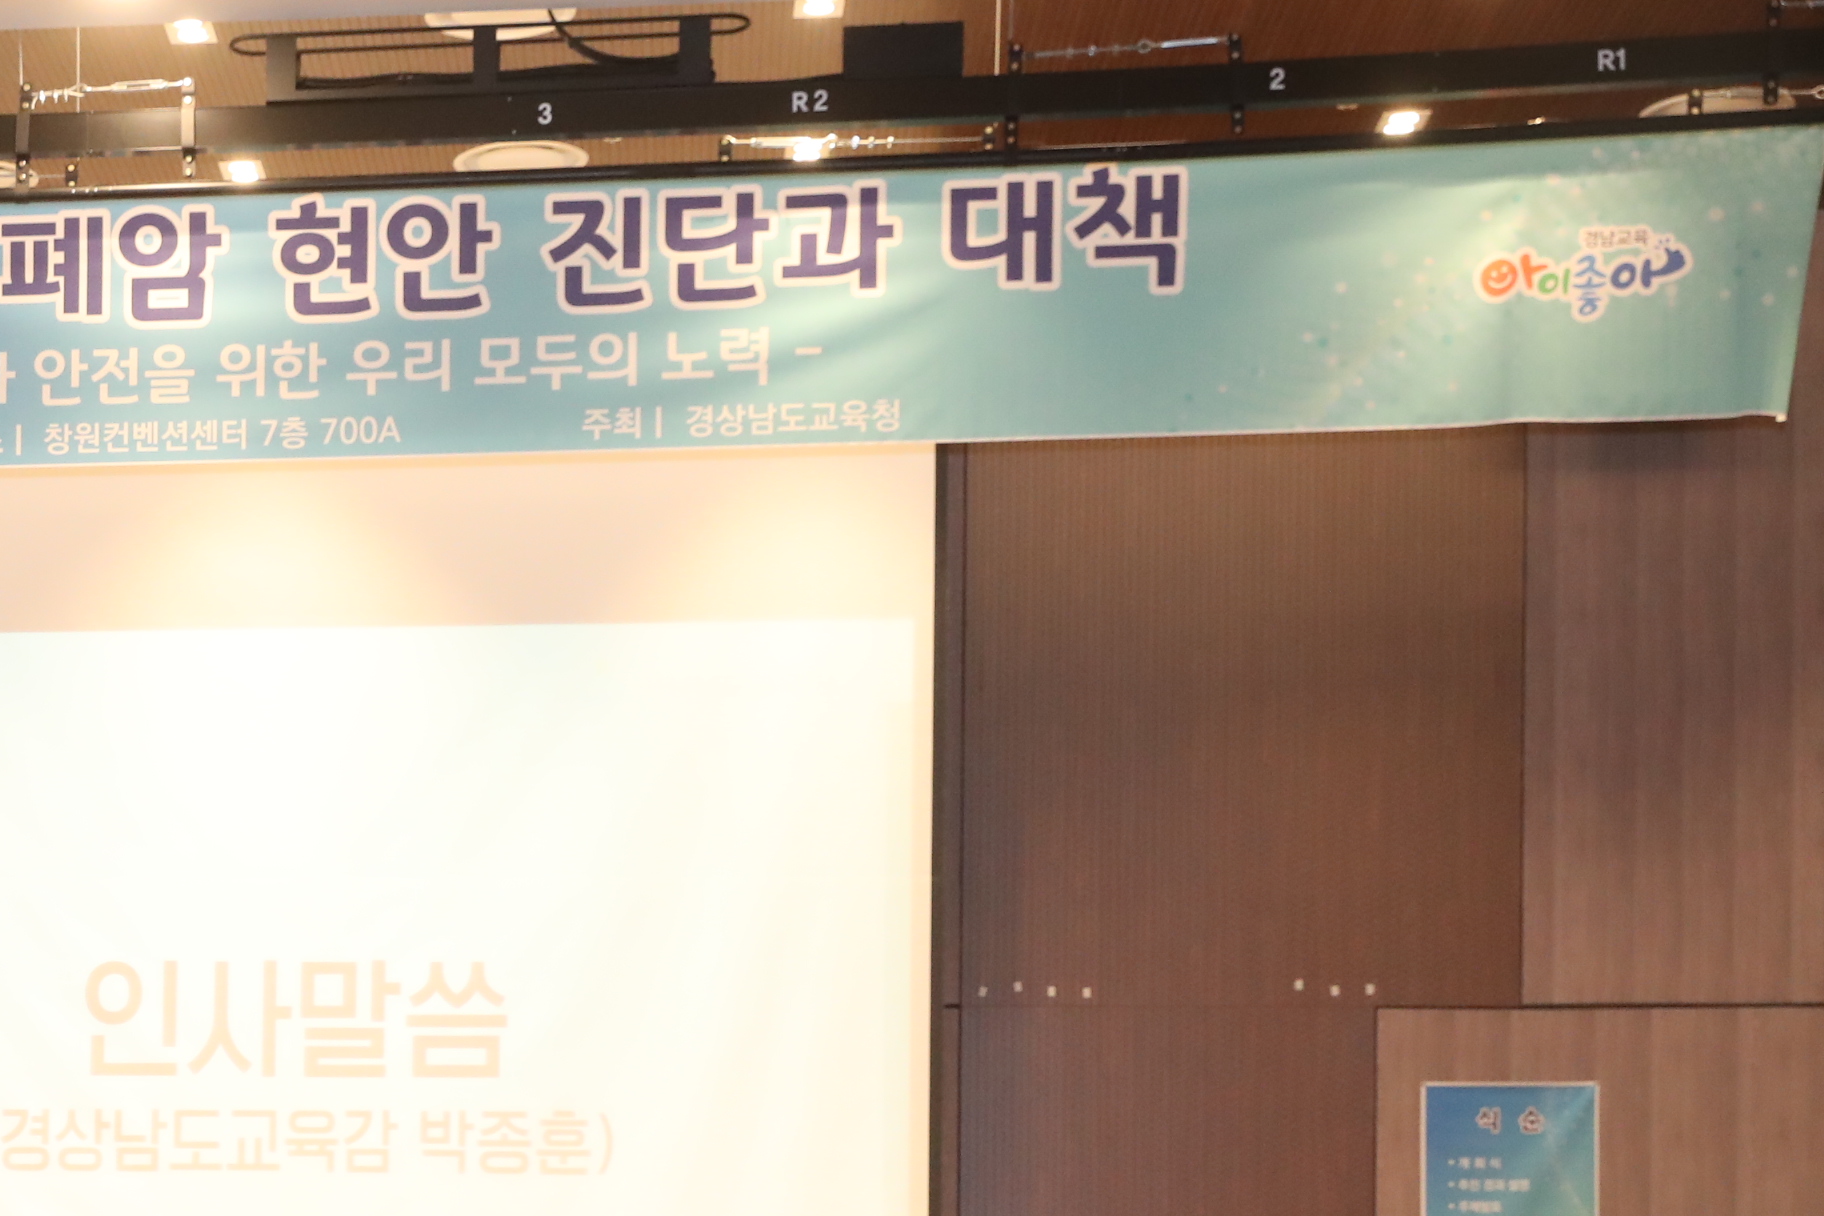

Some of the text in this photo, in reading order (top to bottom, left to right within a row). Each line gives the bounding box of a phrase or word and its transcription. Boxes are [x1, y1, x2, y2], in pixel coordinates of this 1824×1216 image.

[1269, 67, 1286, 91] 2
[1597, 48, 1628, 73] R1
[537, 102, 553, 125] 3
[791, 89, 830, 113] R2
[269, 194, 500, 322] 현안
[541, 180, 902, 314] 진단과
[943, 163, 1188, 295] 대책
[33, 344, 195, 405] 안전을
[216, 339, 328, 400] 위한
[345, 338, 452, 397] 우리
[476, 331, 639, 389] 모두의
[661, 327, 771, 386] 노력
[43, 417, 249, 457] 창원컨벤션센터
[260, 417, 308, 450] 7층
[319, 416, 402, 445] 700A
[685, 399, 903, 437] 경상남도교육청
[84, 959, 508, 1079] 인사말씀
[419, 1108, 615, 1177] 박종훈)
